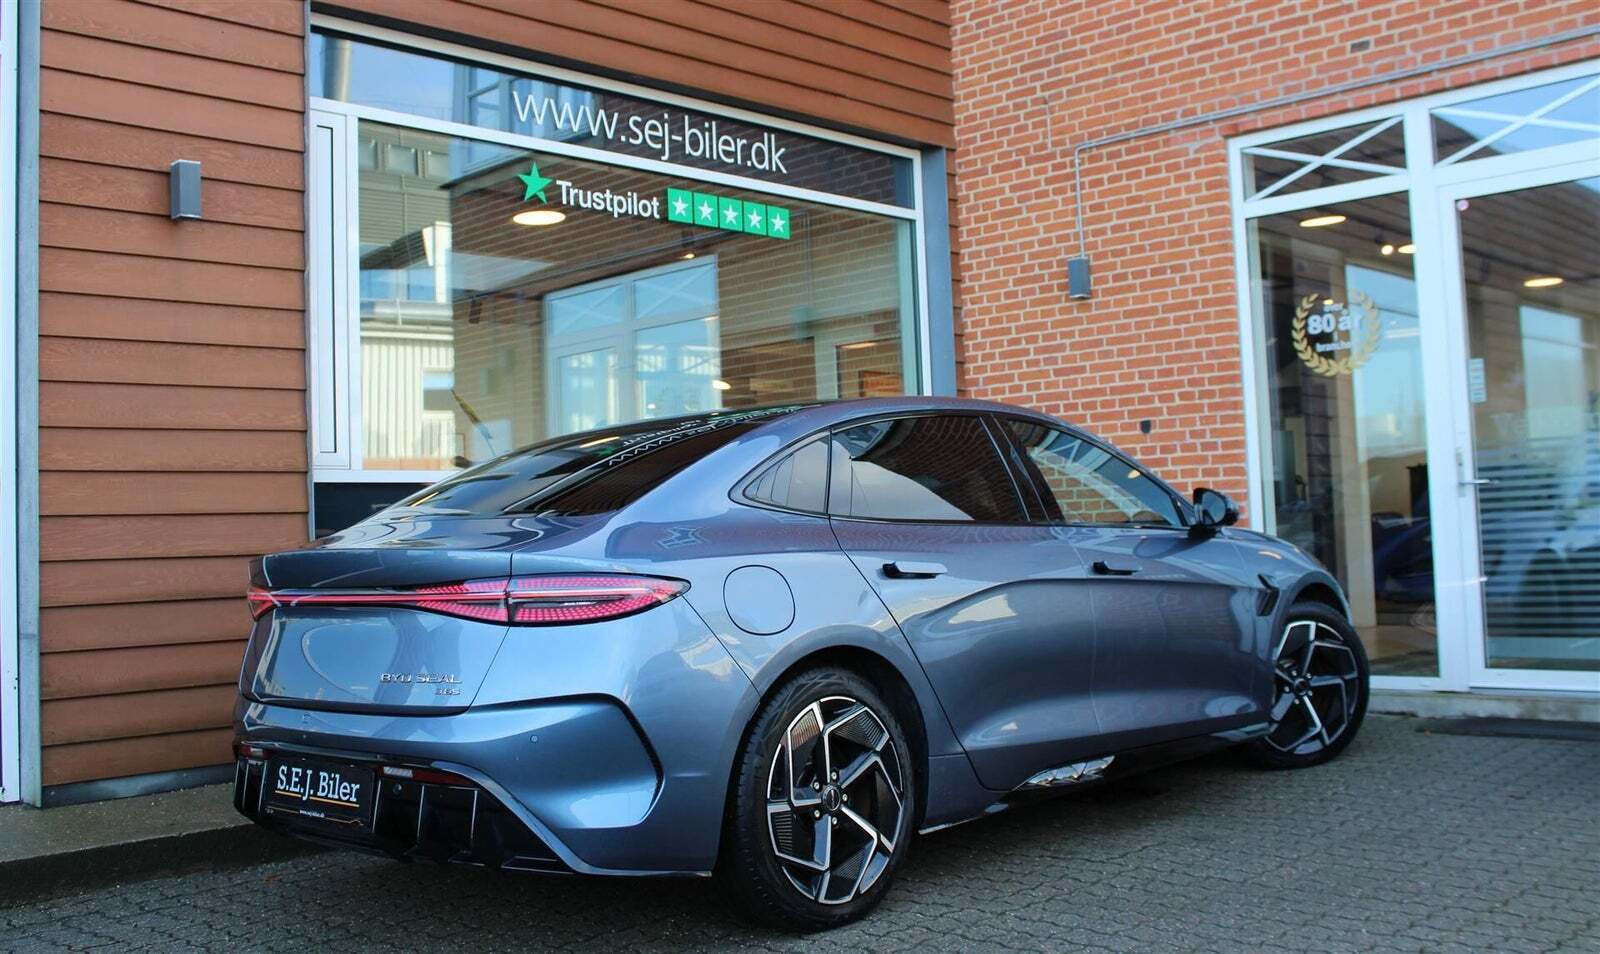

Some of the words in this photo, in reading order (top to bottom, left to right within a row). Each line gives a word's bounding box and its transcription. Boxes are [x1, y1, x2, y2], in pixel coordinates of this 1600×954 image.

[513, 91, 788, 174] www.sej-biler.dk
[556, 179, 660, 219] Trustpilot
[1307, 313, 1336, 335] 80
[415, 673, 462, 683] SEAL
[277, 765, 314, 801] S.E.J.
[317, 771, 360, 802] Biler
